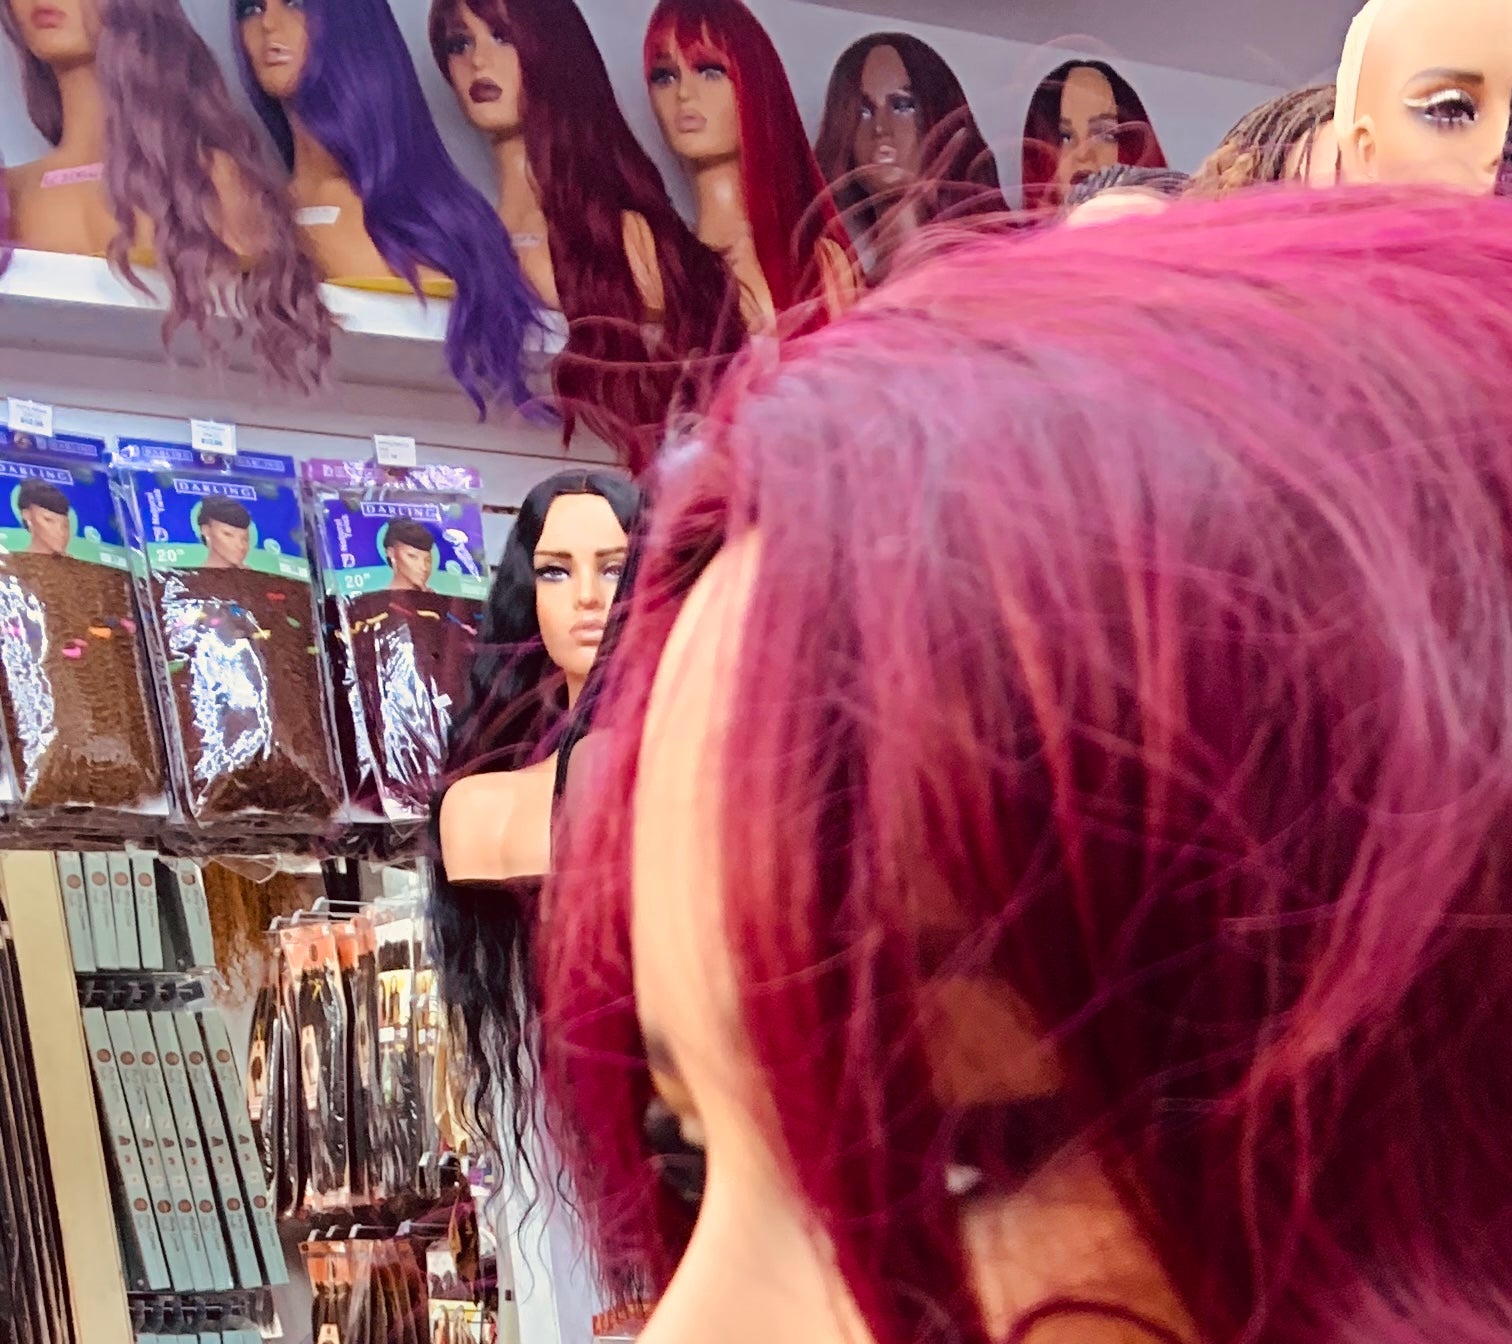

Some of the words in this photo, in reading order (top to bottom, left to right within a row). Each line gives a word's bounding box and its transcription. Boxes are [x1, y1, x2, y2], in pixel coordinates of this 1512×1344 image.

[0, 462, 68, 481] DARLING
[177, 481, 253, 498] DARLING
[365, 505, 439, 519] DARLING
[344, 573, 371, 589] 20"
